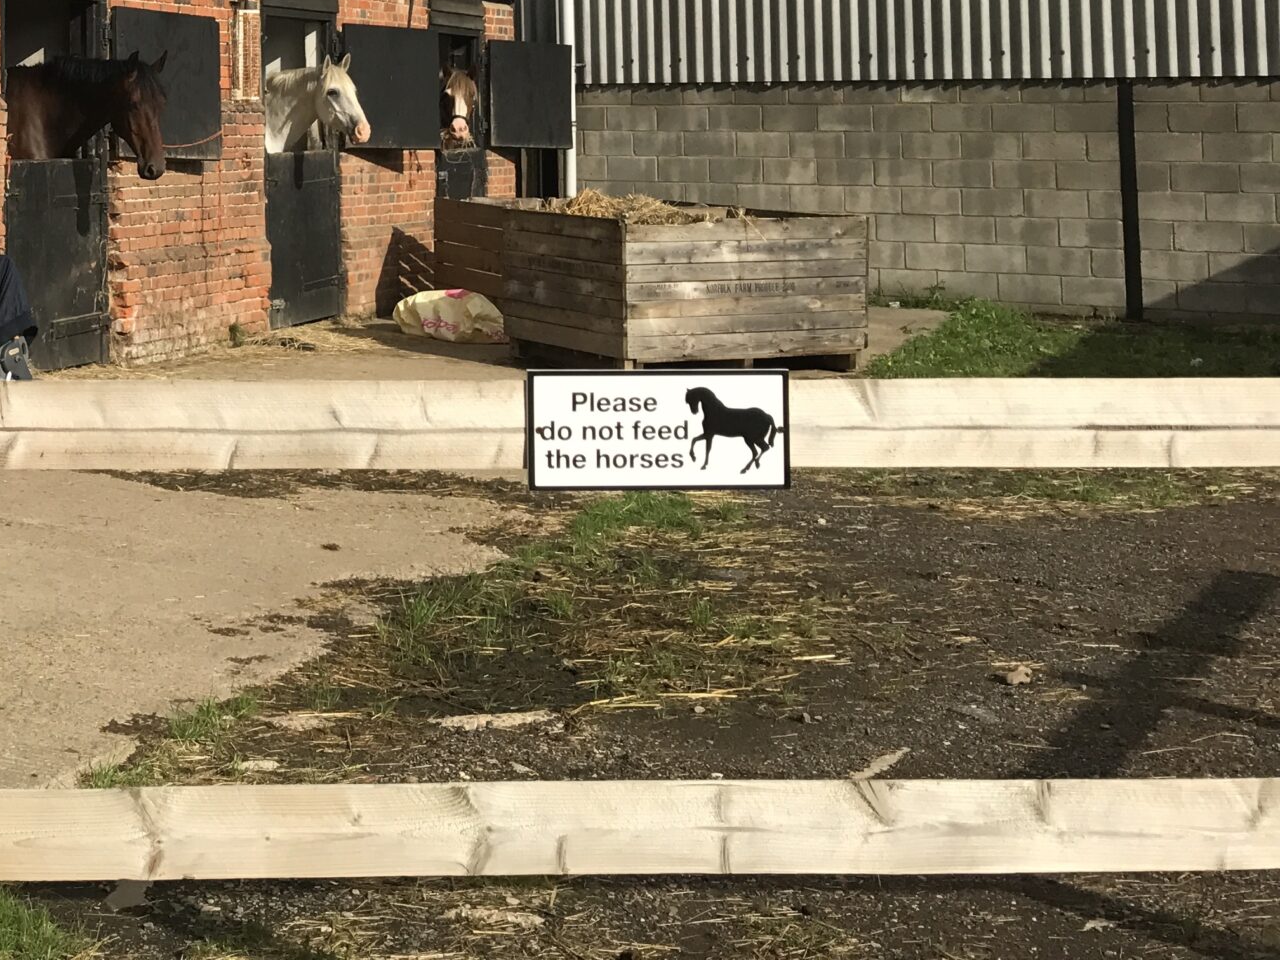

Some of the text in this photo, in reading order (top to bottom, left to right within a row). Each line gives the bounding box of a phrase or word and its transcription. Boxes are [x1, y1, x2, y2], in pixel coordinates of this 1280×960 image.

[734, 282, 752, 293] FARM
[571, 392, 658, 412] Please
[540, 420, 688, 441] do not feed
[545, 449, 684, 469] the horses
